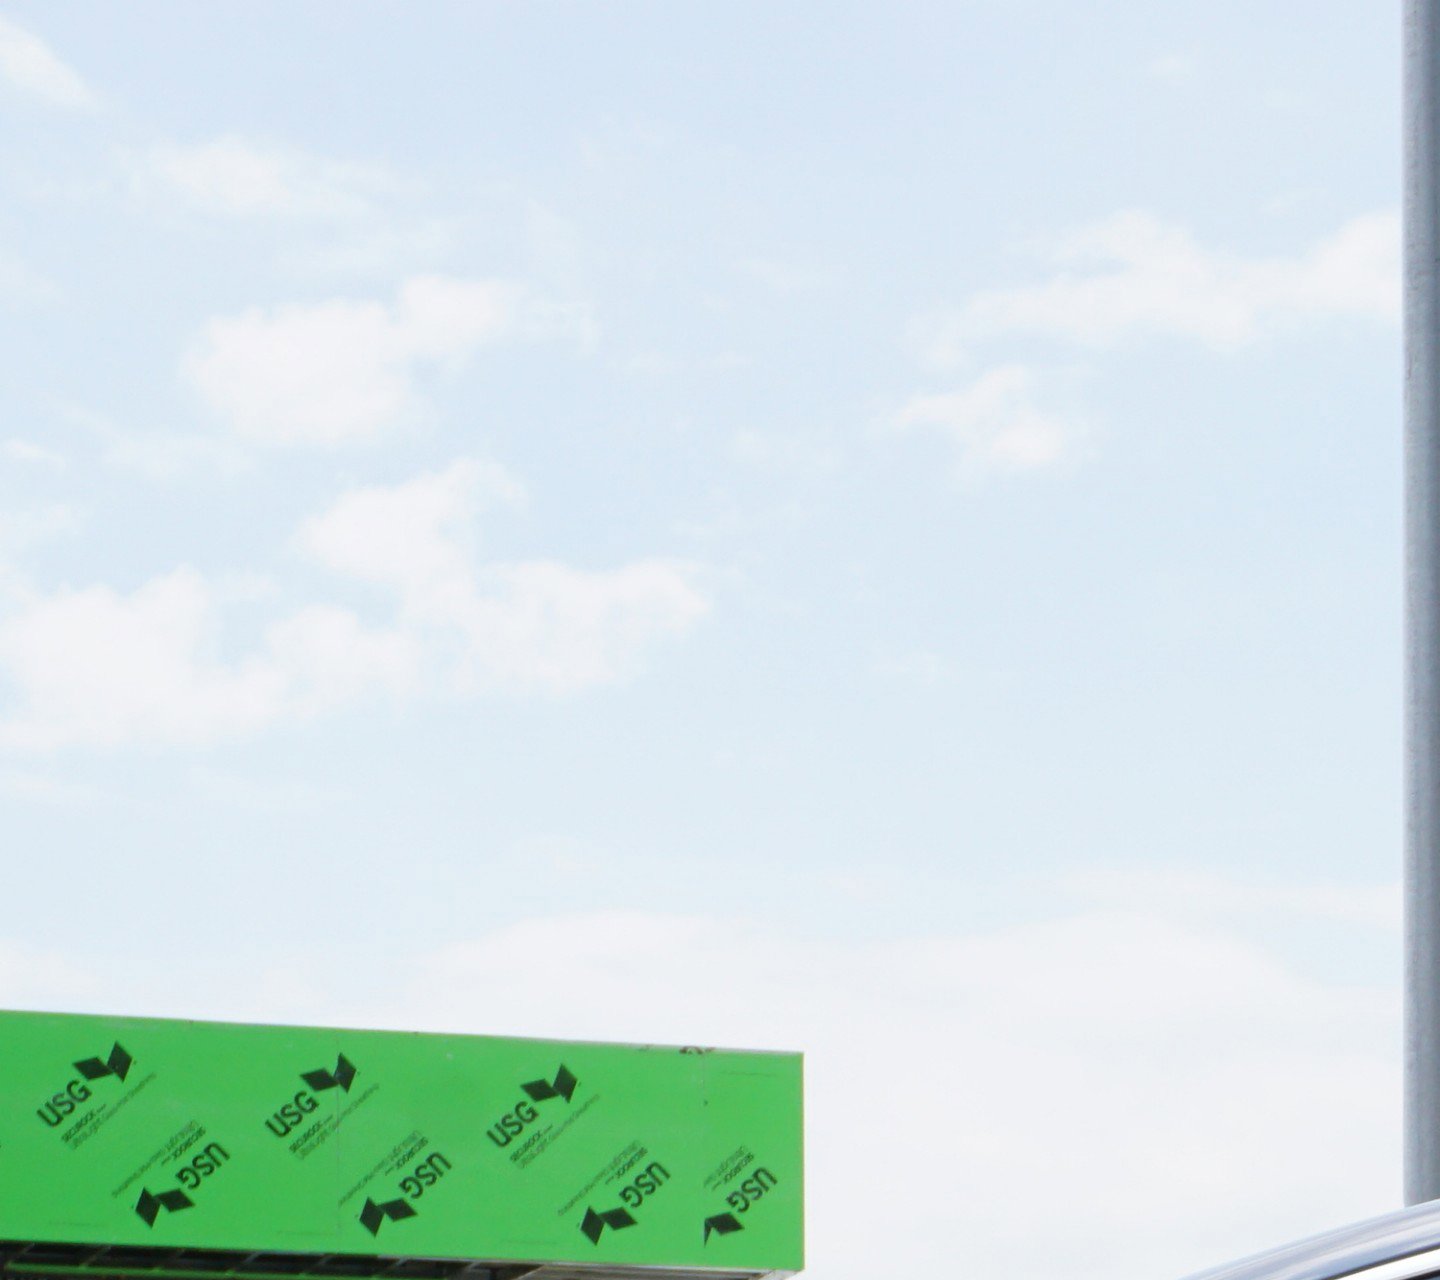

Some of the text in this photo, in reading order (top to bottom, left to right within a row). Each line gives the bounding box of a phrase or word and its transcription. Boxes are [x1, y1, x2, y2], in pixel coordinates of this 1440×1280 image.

[37, 1079, 91, 1128] USG
[265, 1090, 320, 1138] USG
[487, 1100, 538, 1148] USG
[175, 1143, 230, 1190] USG
[399, 1152, 452, 1199] USG
[618, 1161, 671, 1208] USG
[727, 1166, 778, 1213] USG
